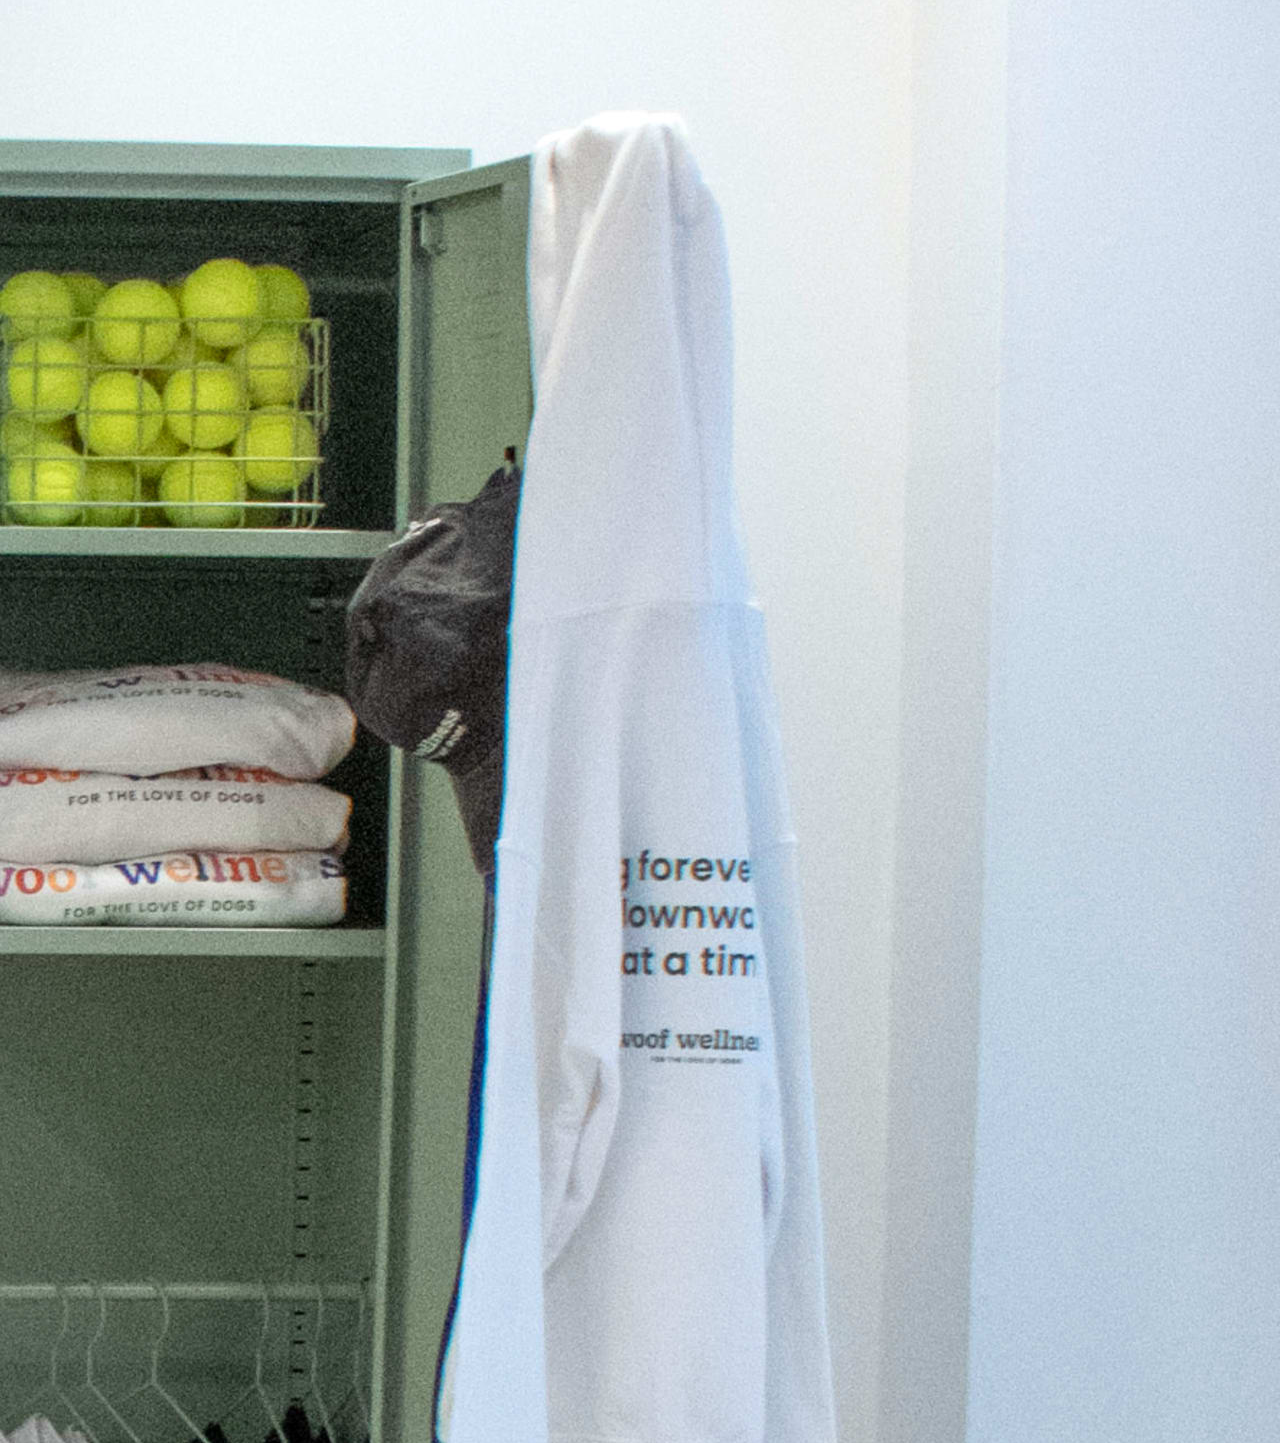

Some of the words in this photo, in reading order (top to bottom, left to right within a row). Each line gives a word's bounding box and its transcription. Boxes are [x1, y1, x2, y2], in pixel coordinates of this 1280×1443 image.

[68, 793, 101, 806] FOR
[107, 790, 137, 802] THE
[142, 790, 184, 802] LOVE
[190, 791, 211, 802] OF
[217, 791, 265, 805] DOGS
[115, 852, 346, 885] wellnes
[638, 849, 751, 882] foreve
[63, 906, 96, 918] FOR
[103, 902, 132, 914] THE
[139, 901, 180, 913] LOVE
[185, 900, 206, 912] OF
[211, 899, 256, 912] DOGS
[621, 946, 654, 975] at
[662, 952, 687, 975] a
[700, 944, 756, 976] tim
[676, 1028, 759, 1051] wellne
